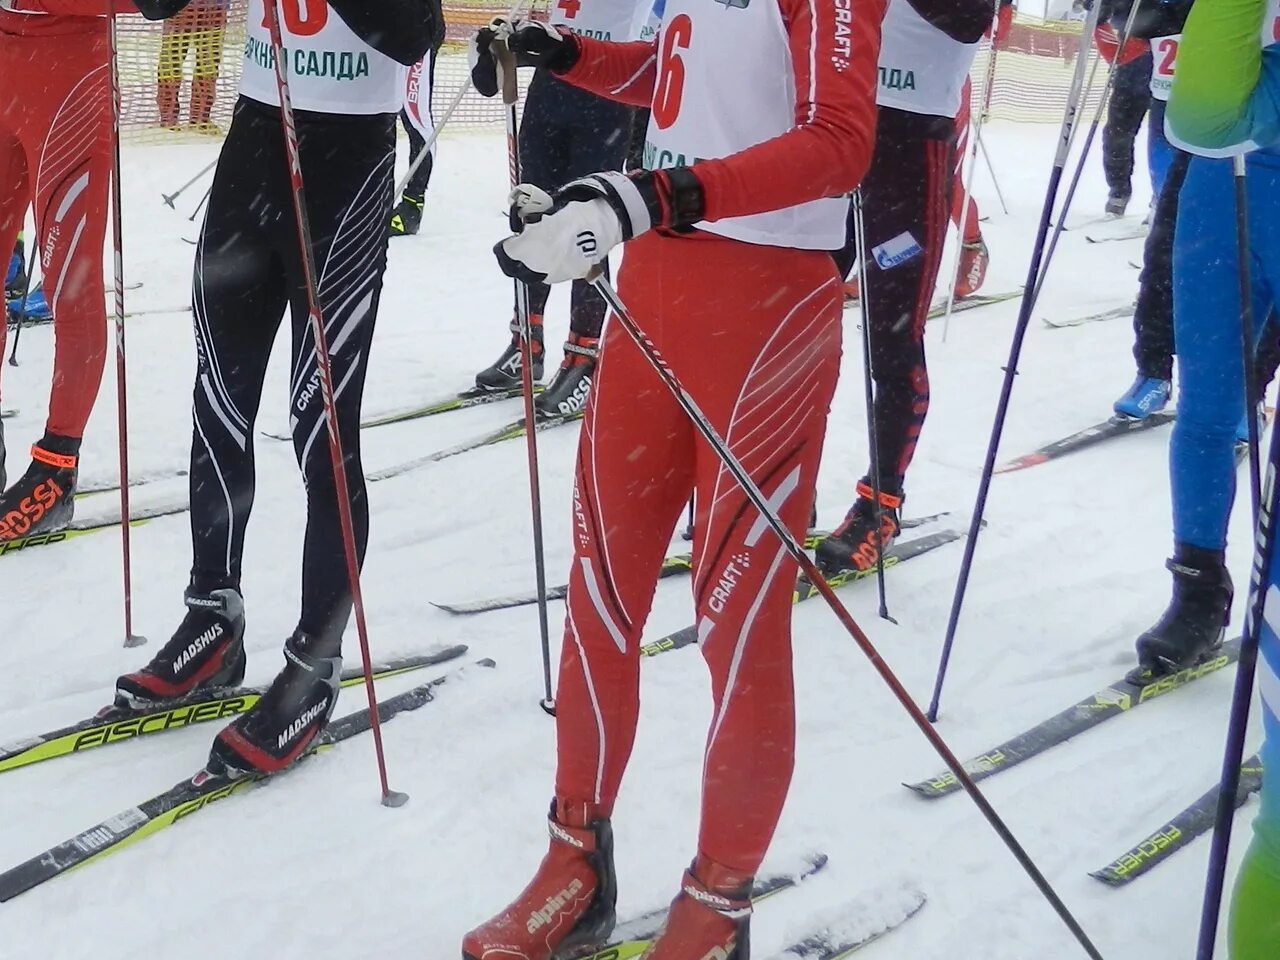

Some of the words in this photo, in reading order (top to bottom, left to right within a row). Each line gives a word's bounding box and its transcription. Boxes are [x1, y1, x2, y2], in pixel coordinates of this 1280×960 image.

[294, 49, 369, 81] САЛДА
[653, 14, 692, 130] 6
[43, 232, 57, 268] CRAFT
[708, 562, 742, 614] CRAFT
[172, 623, 224, 674] MADSHUS
[1139, 655, 1229, 704] FISCHER
[73, 697, 246, 752] FISCHER
[278, 696, 328, 749] MADSHUS
[1106, 824, 1181, 875] FISCHER
[526, 878, 584, 934] alpina
[684, 884, 731, 906] alpina
